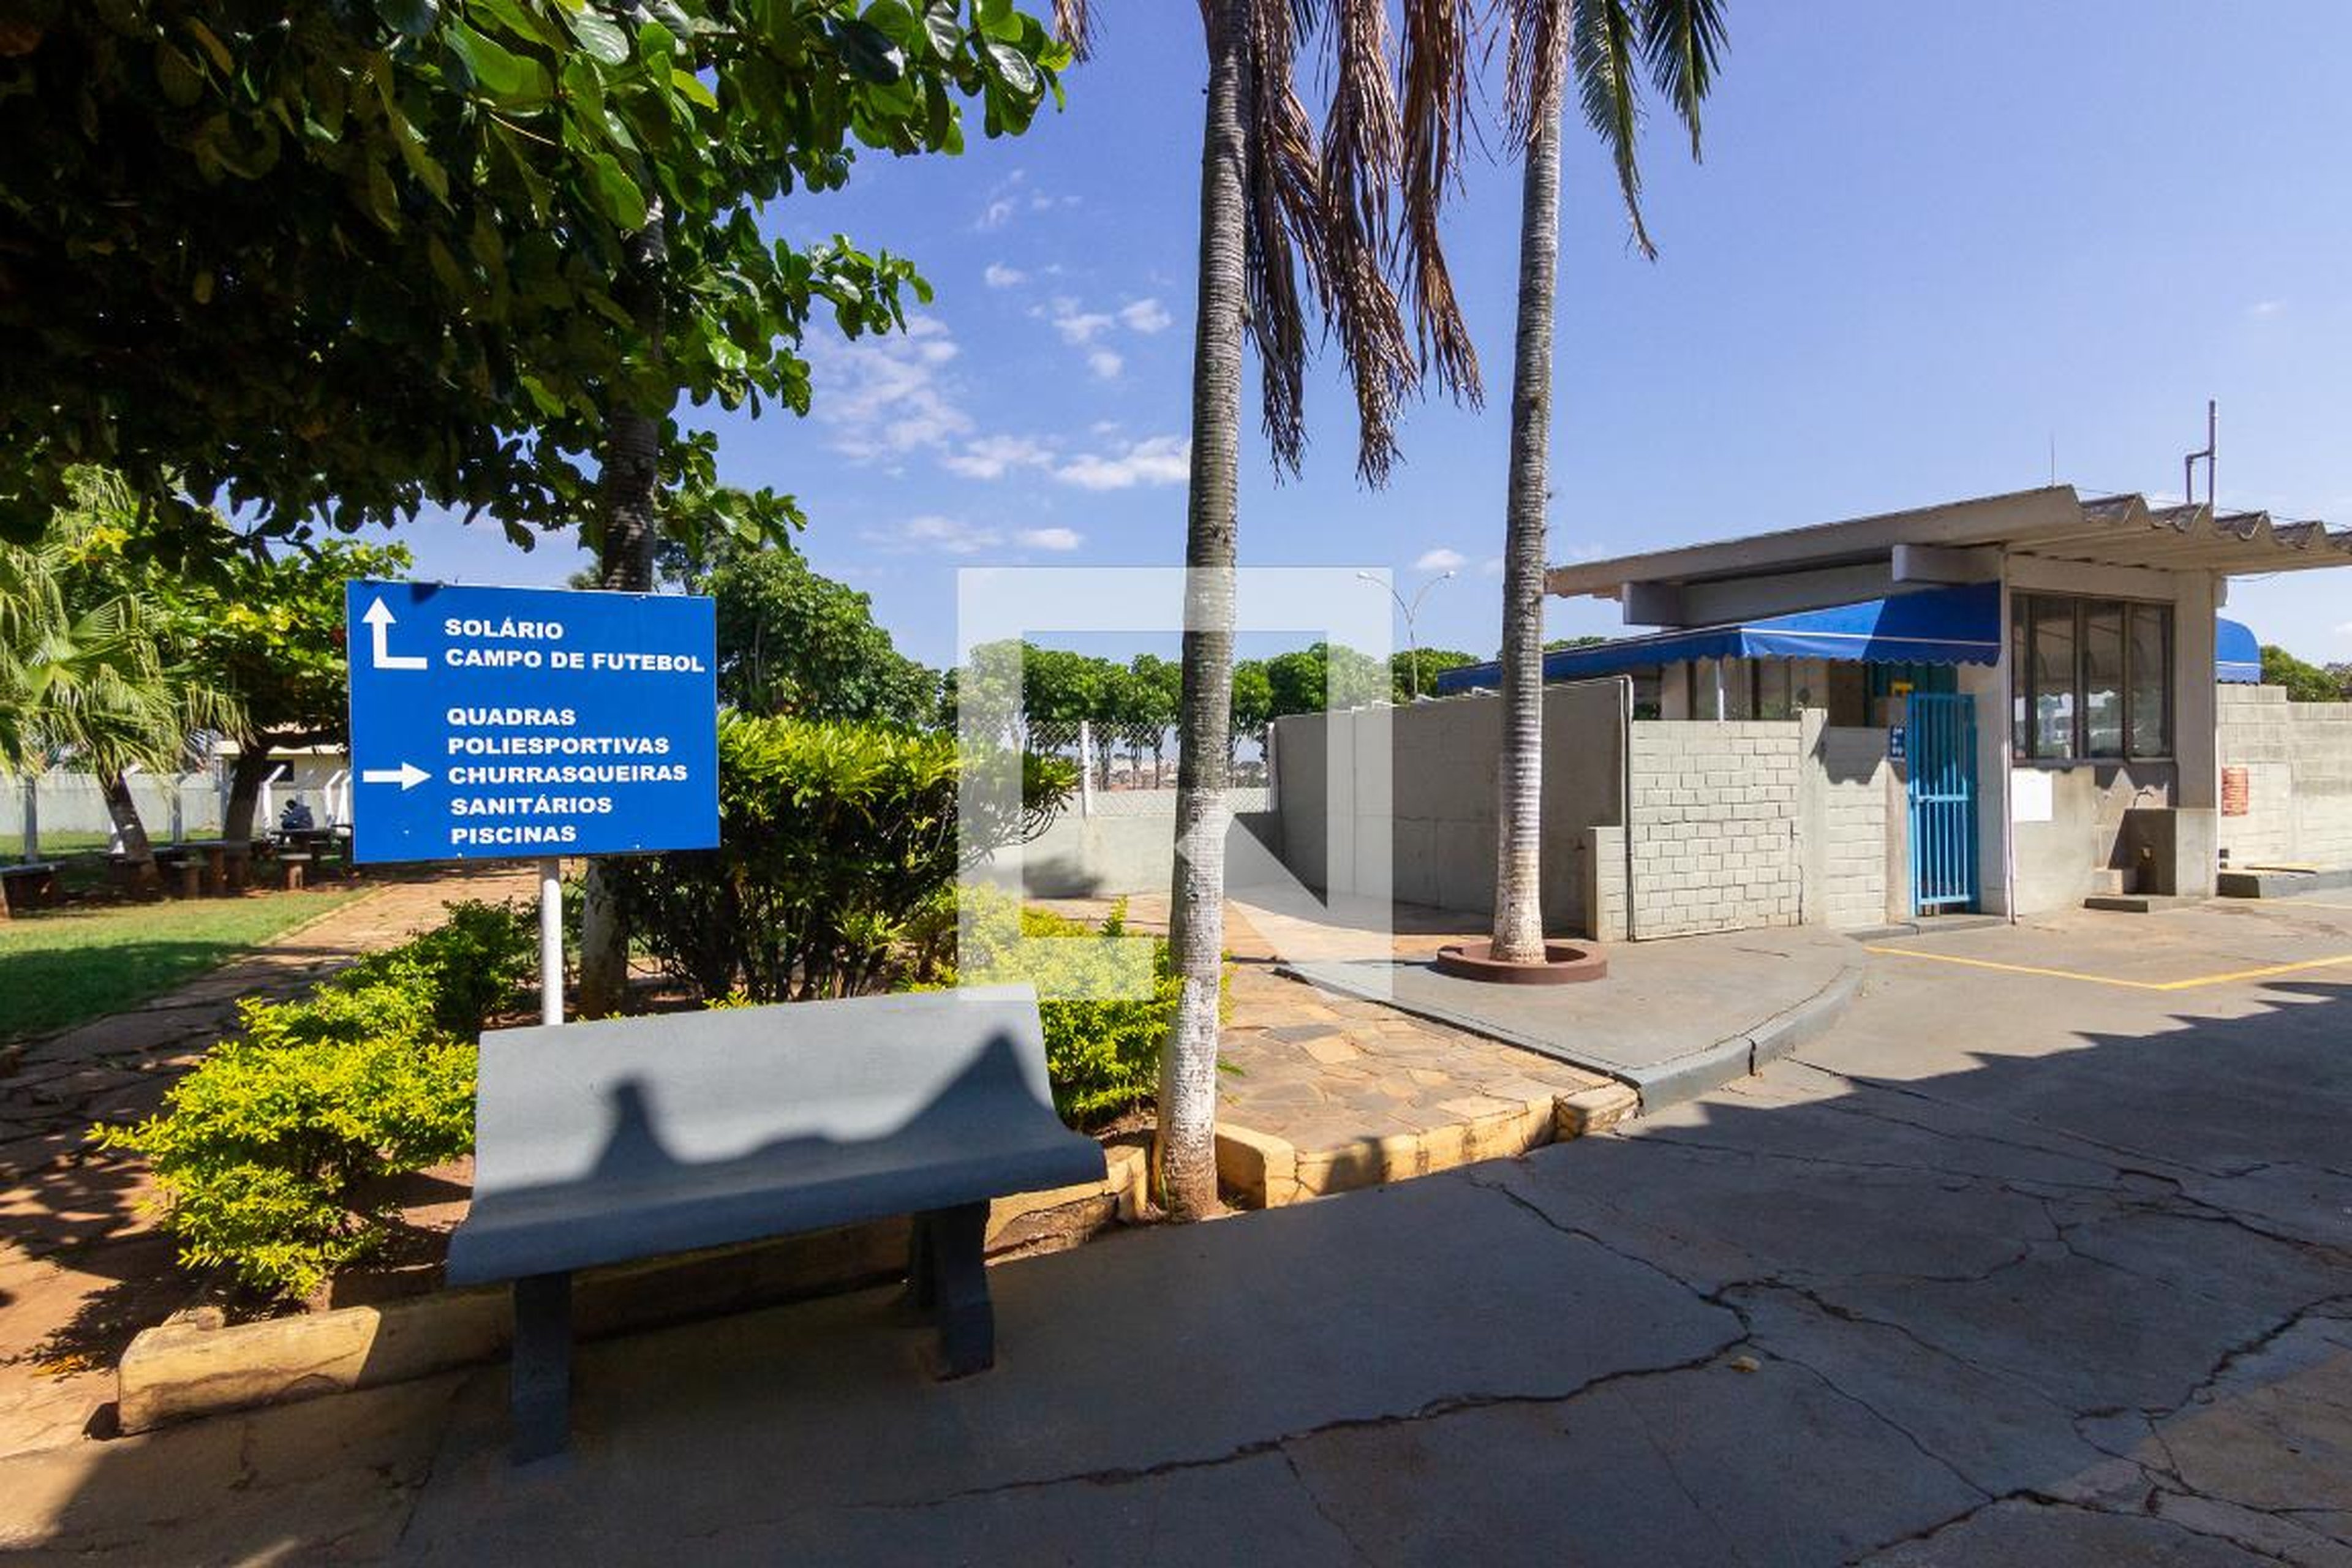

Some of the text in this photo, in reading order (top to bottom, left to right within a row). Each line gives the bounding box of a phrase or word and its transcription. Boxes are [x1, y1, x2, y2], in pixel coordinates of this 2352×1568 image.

[445, 617, 564, 639] SOLÁRIO
[445, 648, 706, 673] CAMPO DE FUTEBOL
[447, 707, 576, 726] QUADRAS
[448, 737, 670, 755] POLIESPORTIVAS
[448, 764, 688, 785] CHURRASQUEIRAS
[451, 794, 612, 816] SANITÁRIOS
[451, 825, 576, 845] PISCINAS
